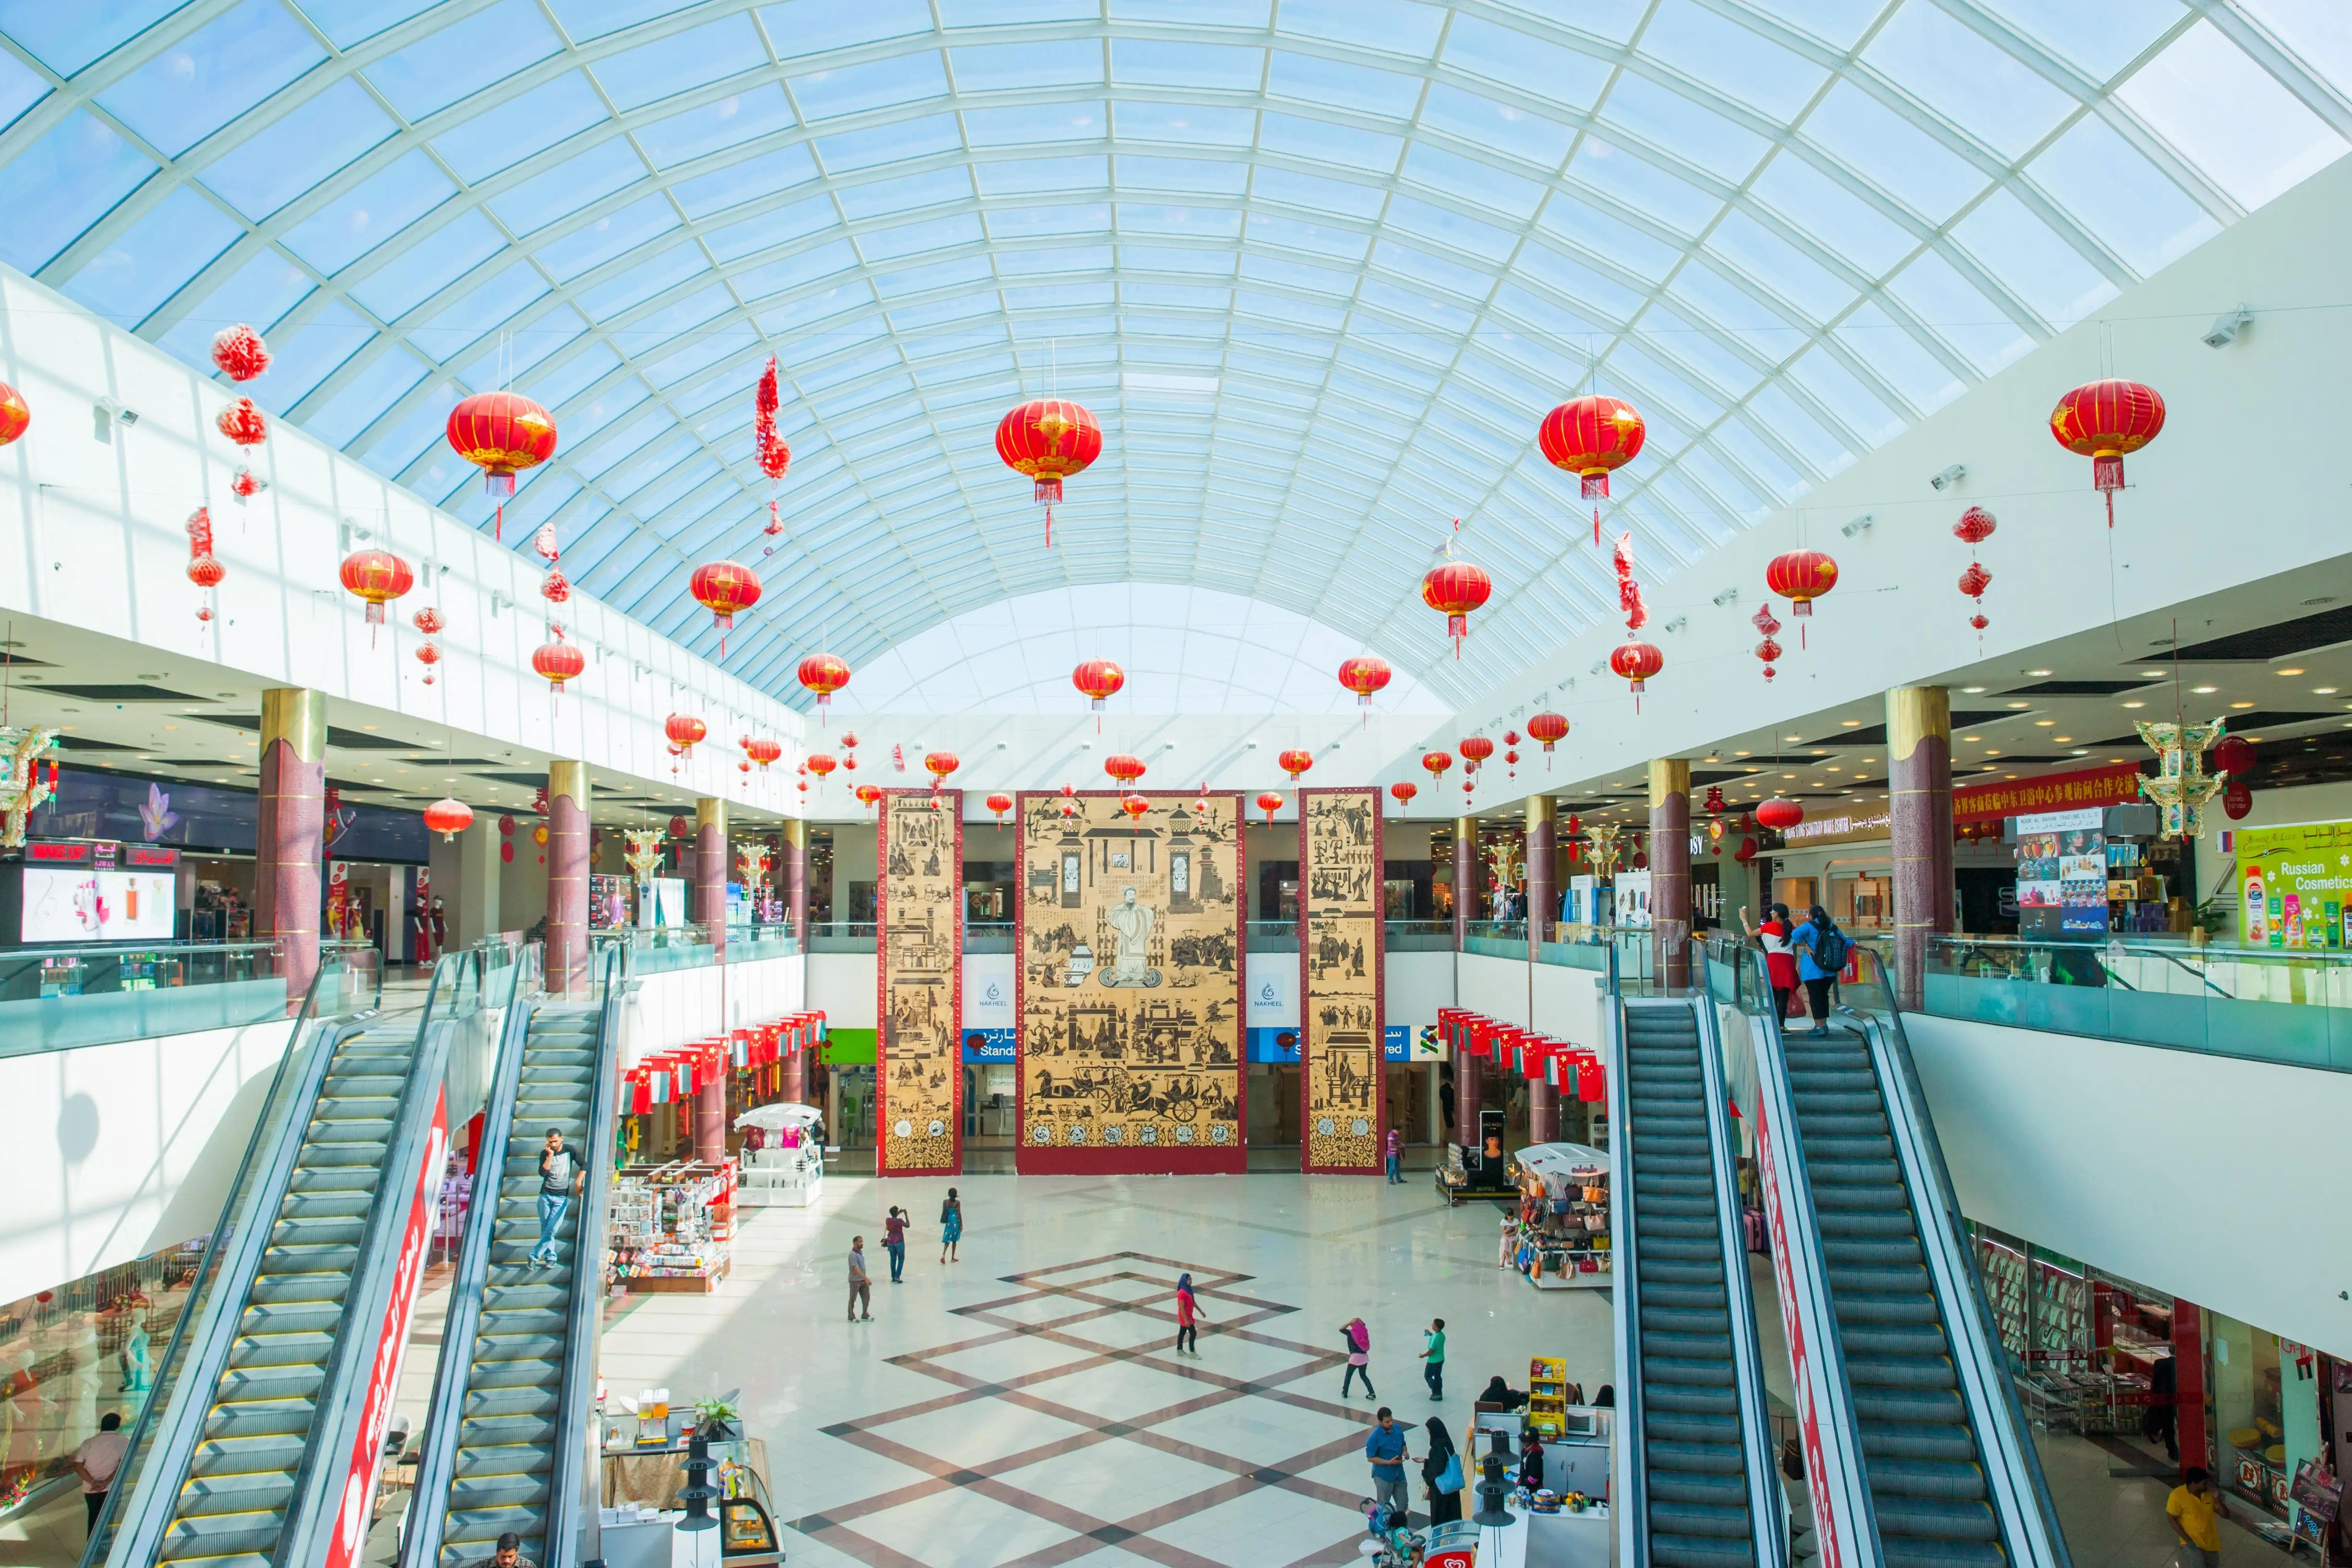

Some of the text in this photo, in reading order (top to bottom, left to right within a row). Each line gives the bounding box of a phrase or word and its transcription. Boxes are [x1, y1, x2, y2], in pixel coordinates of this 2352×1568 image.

[34, 844, 85, 860] MAKE UP
[2281, 861, 2325, 875] Russian
[2296, 874, 2352, 891] Cosmetics
[1776, 1223, 1796, 1351] court
[2143, 1288, 2174, 1306] International
